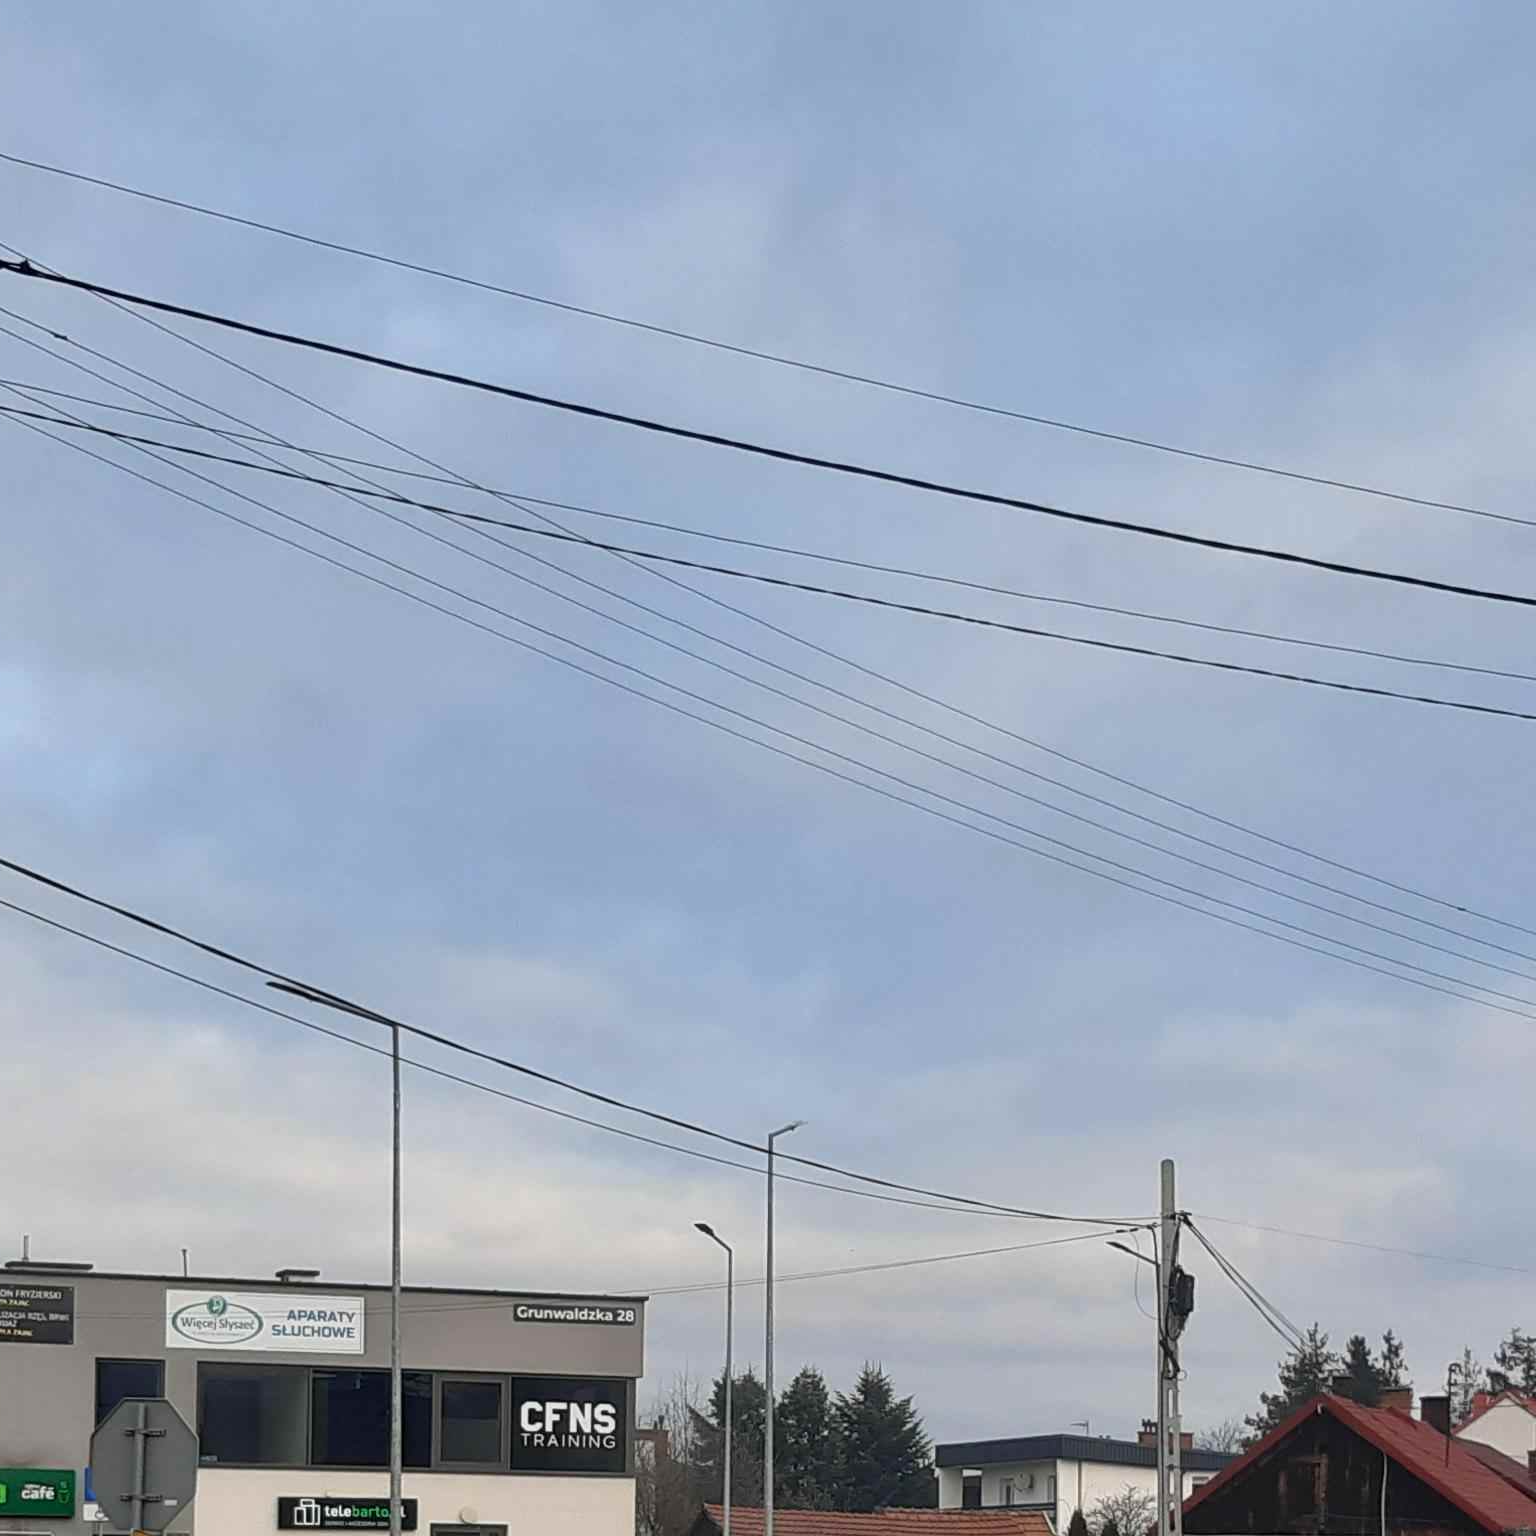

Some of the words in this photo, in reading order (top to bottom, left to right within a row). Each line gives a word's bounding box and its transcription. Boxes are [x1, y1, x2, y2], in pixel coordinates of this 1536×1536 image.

[287, 1310, 355, 1323] APARATY
[517, 1306, 613, 1321] Grunwaldzka
[617, 1310, 634, 1322] 28
[181, 1317, 217, 1331] Więcej
[272, 1325, 355, 1338] SŁUCHOWE
[521, 1401, 616, 1434] CFNS
[520, 1433, 616, 1449] TRAINING
[21, 1486, 56, 1500] café
